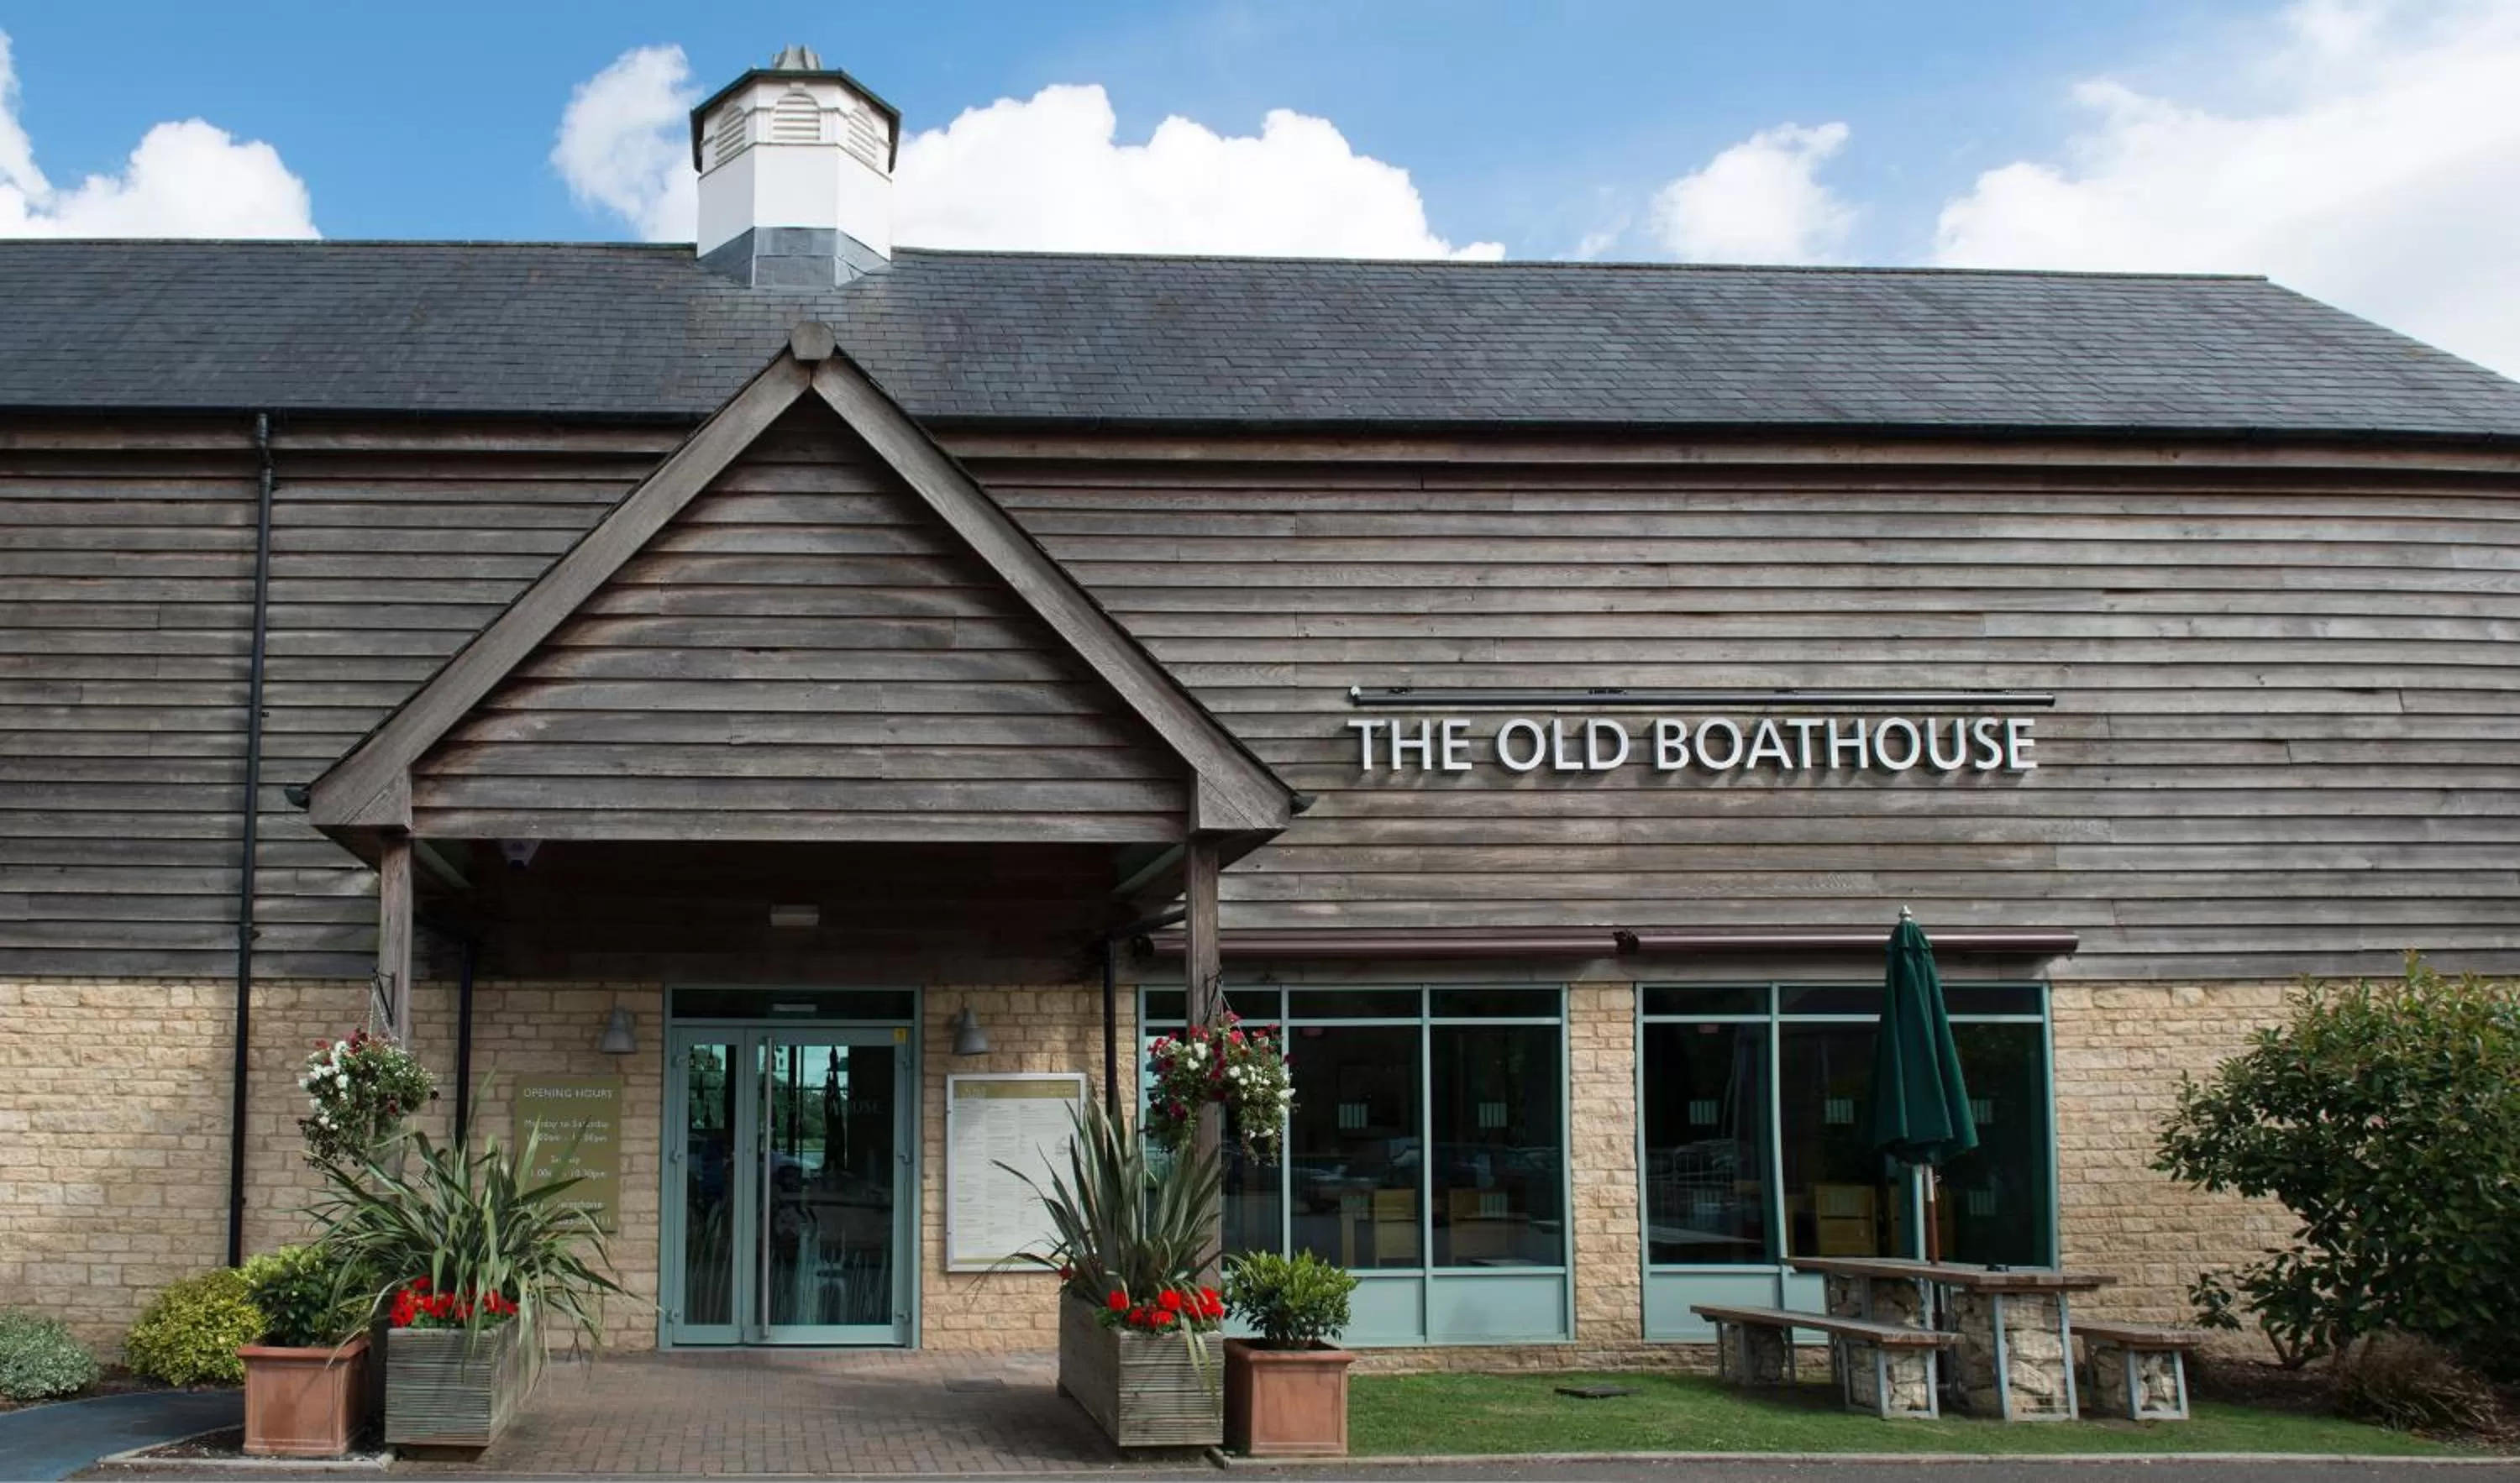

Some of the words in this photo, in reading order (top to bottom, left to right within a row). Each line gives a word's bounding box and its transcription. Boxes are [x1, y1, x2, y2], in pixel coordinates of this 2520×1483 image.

[1347, 718, 1473, 771] THE
[1496, 717, 1630, 773] OLD
[1655, 716, 2039, 772] BOATHOUSE
[523, 1088, 572, 1098] OPENING
[575, 1088, 612, 1099] HOURS
